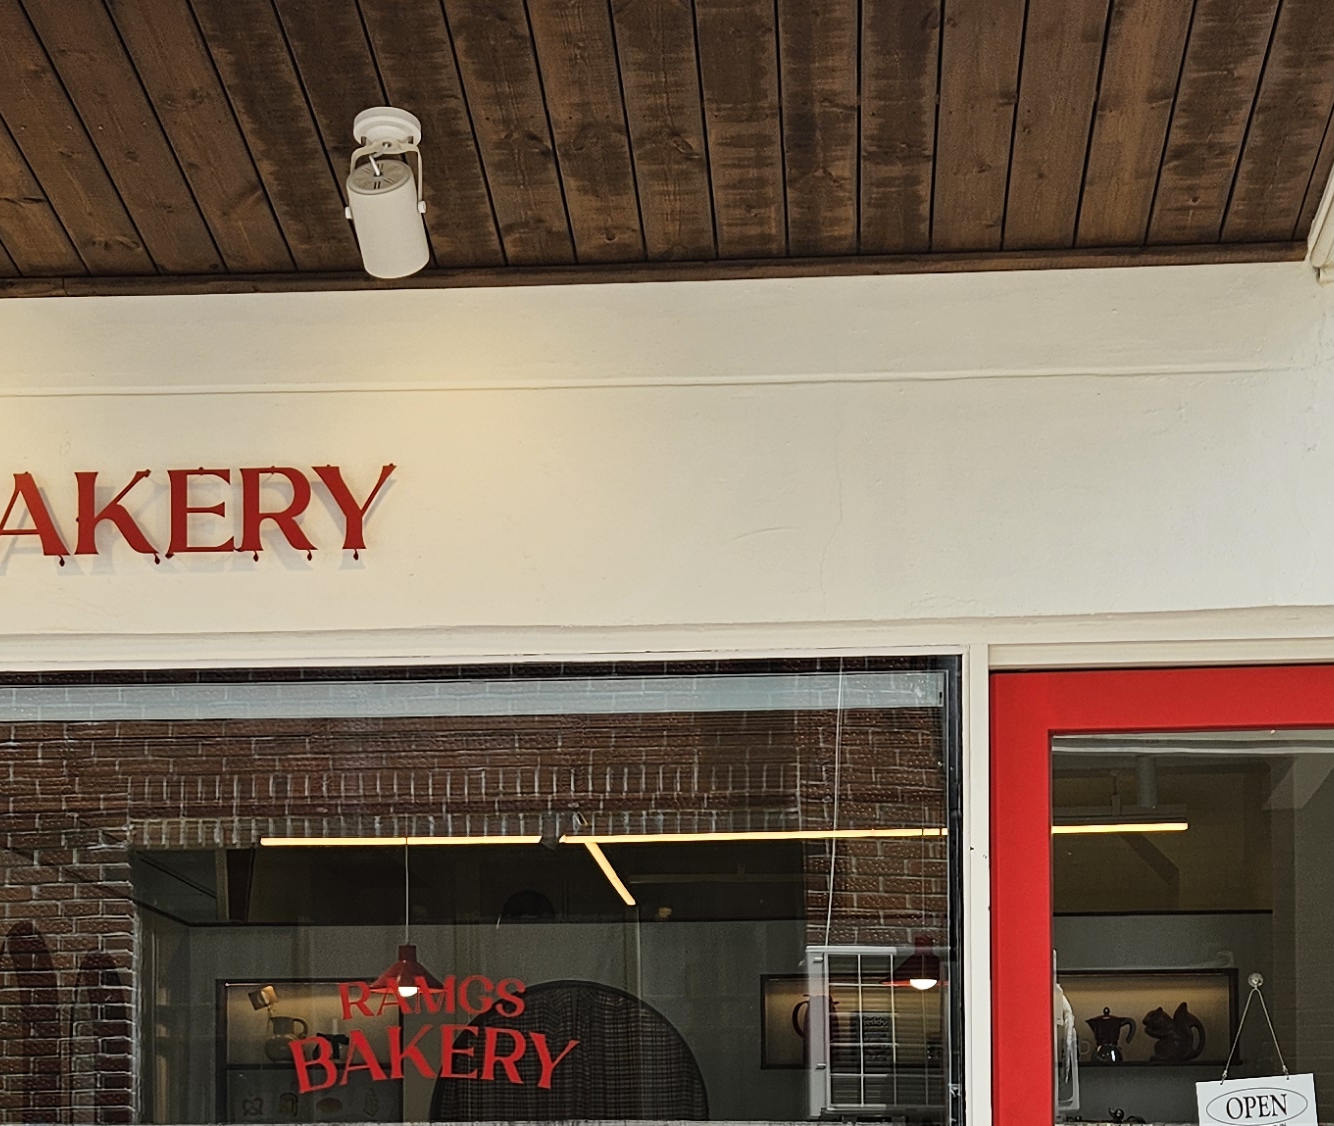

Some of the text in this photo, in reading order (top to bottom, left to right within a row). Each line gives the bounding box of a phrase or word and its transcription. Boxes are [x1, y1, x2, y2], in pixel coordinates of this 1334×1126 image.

[340, 975, 527, 1020] RAMGS
[288, 1024, 580, 1094] BAKERY
[1226, 1093, 1287, 1119] OPEN
